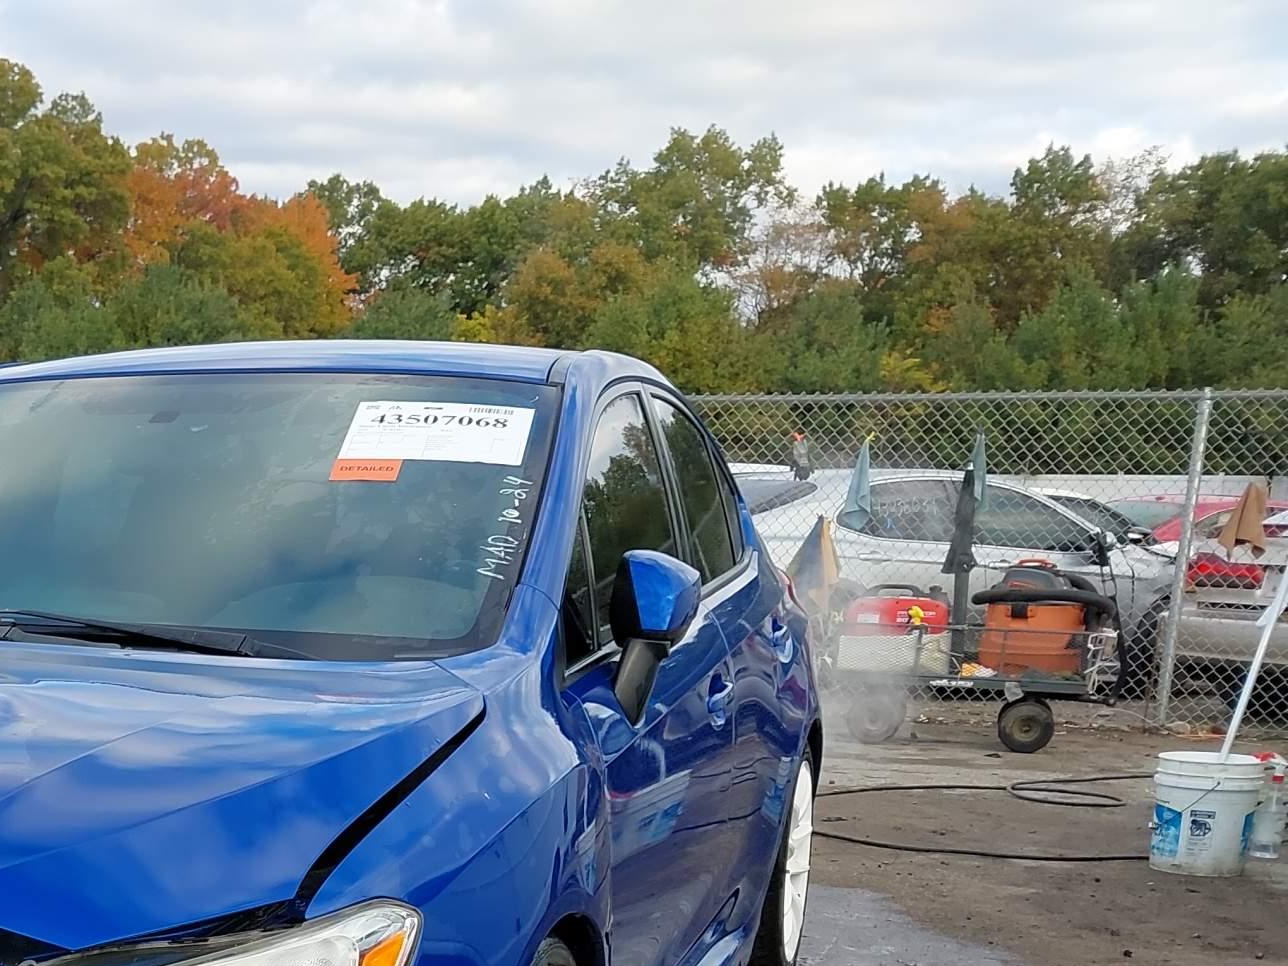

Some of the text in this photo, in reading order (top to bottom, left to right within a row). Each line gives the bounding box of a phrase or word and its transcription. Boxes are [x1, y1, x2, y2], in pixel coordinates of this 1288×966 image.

[370, 413, 509, 429] 43507068
[339, 464, 395, 472] DETAILED
[476, 475, 534, 580] MAD 10-24
